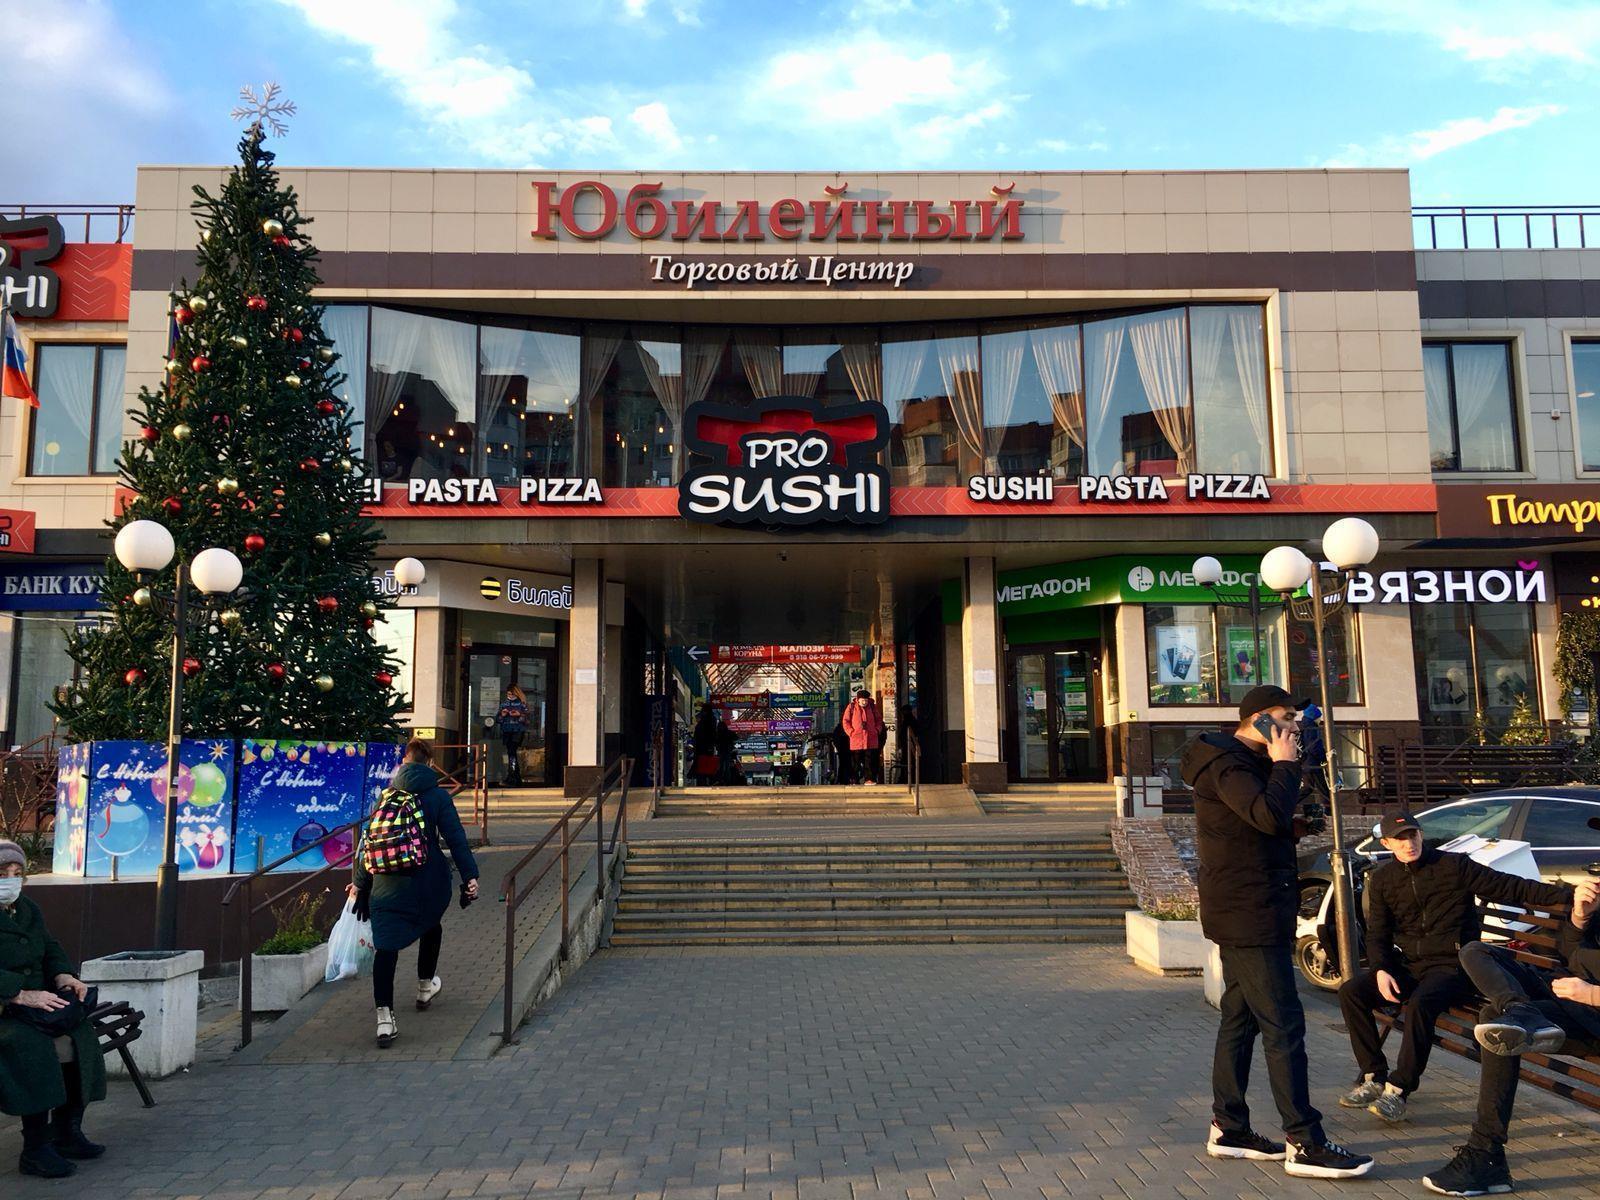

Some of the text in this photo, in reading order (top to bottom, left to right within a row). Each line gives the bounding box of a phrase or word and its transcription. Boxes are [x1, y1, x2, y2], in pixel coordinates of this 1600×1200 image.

[531, 180, 1026, 241] Юбилейный
[648, 255, 914, 291] Торговый Центр
[745, 437, 828, 469] PRO
[408, 478, 498, 503] PASTA
[520, 477, 603, 502] PIZZA
[688, 472, 881, 515] SUSHI
[968, 474, 1270, 500] SUSHI PASTA PIZZA
[4, 575, 65, 595] БАНК
[997, 576, 1091, 603] МЕГАФОН
[1159, 570, 1264, 587] МЕФО
[779, 645, 825, 653] ЖАЛЮЗИ
